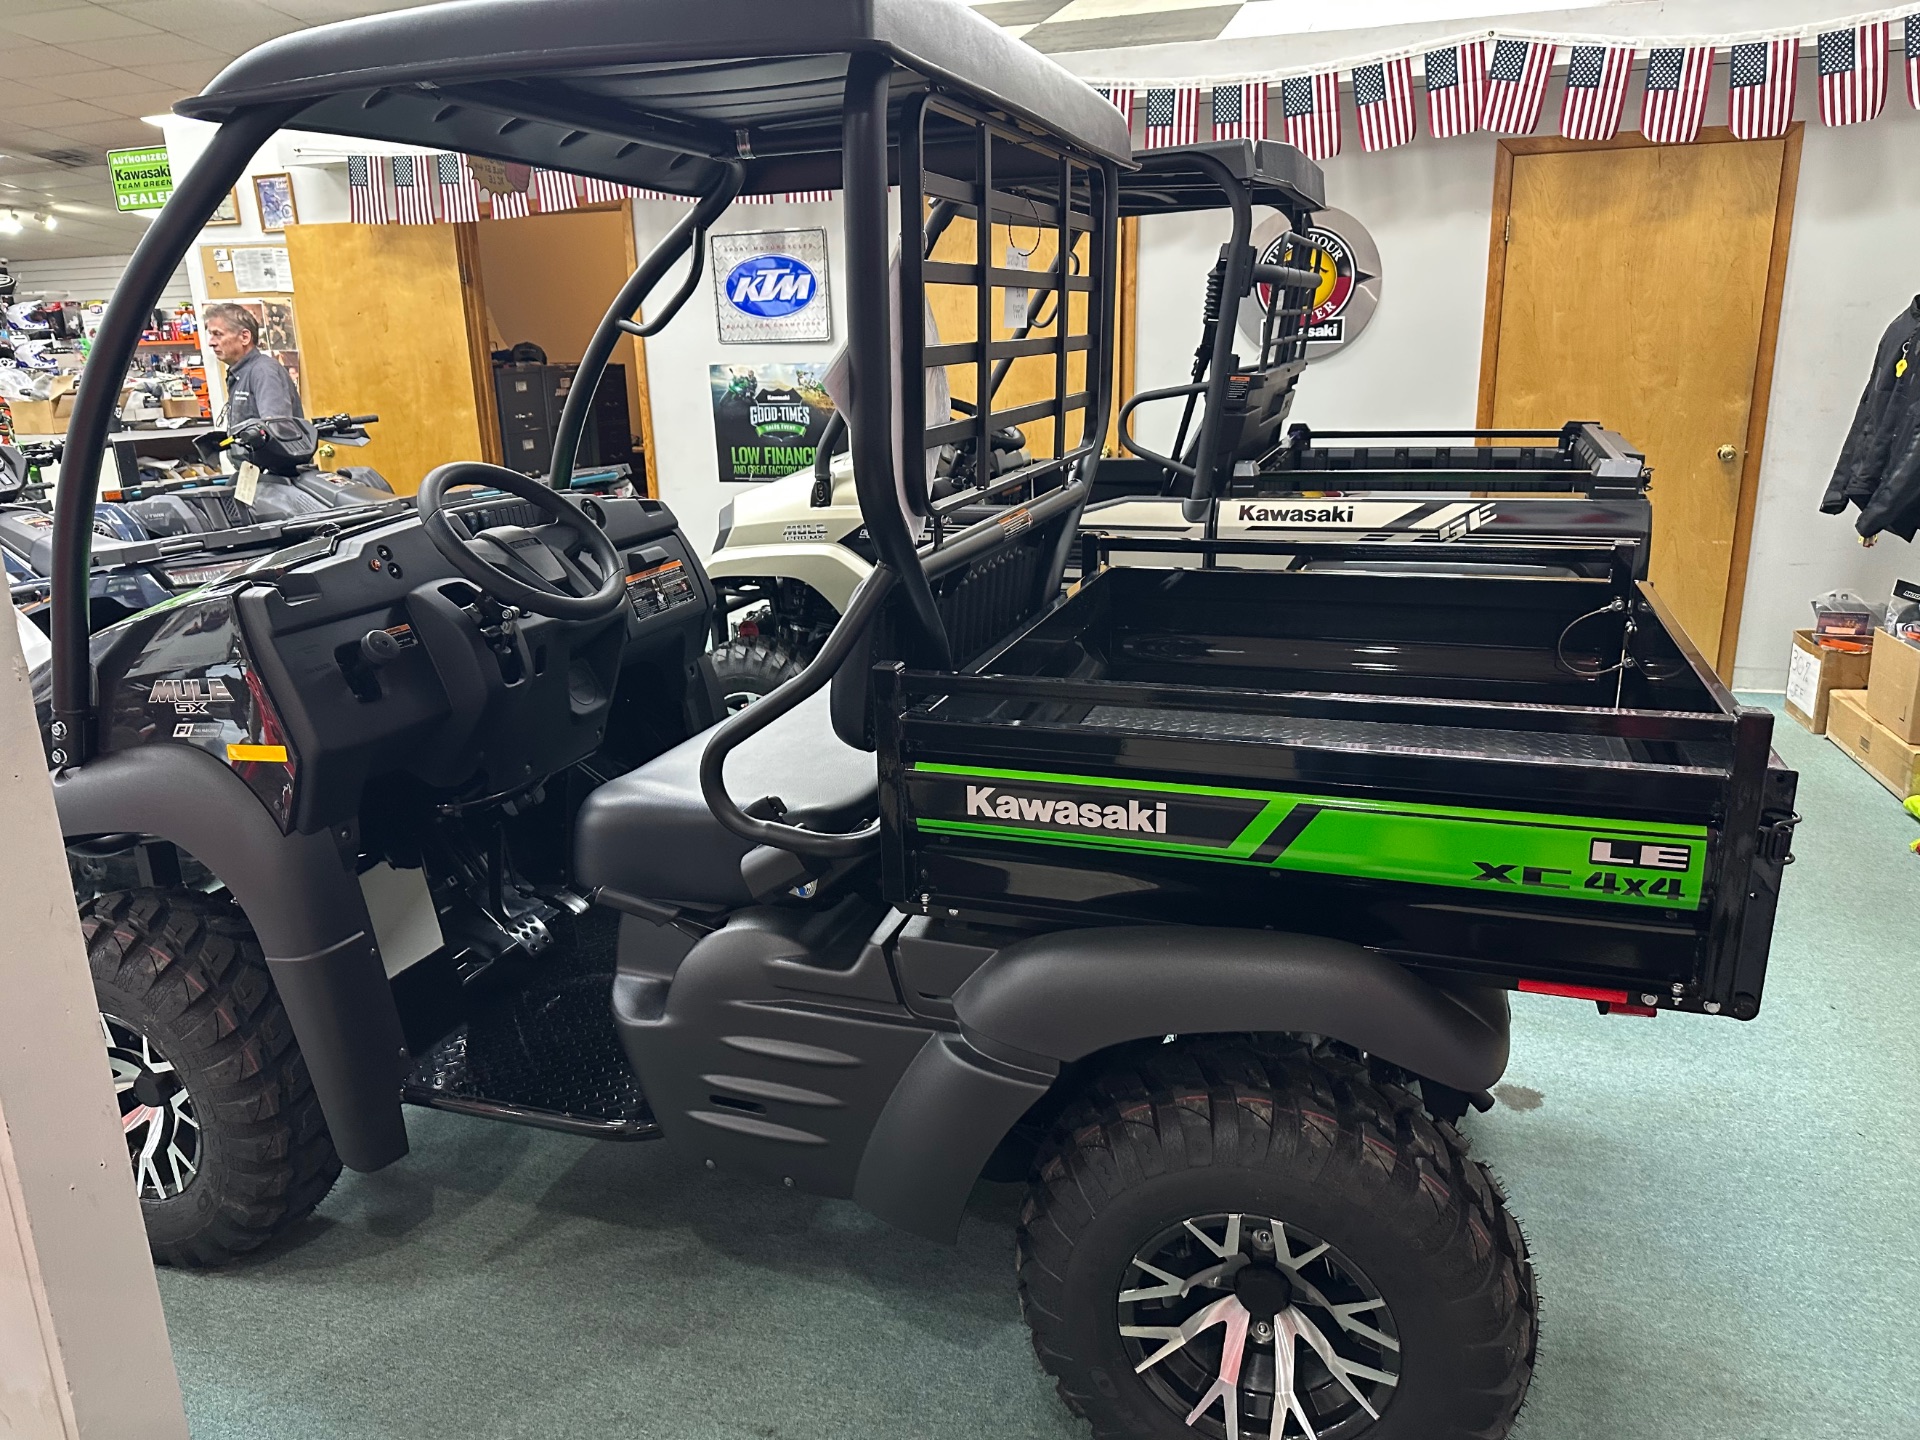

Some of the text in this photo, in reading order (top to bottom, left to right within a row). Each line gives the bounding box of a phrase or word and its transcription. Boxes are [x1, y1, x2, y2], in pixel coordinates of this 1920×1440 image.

[113, 153, 168, 164] AUTHORIZED
[115, 164, 171, 181] Kawasaki
[1309, 233, 1343, 261] TOUR
[733, 268, 811, 302] KTM
[731, 446, 818, 465] LOW FINANCI
[733, 465, 746, 474] AND
[747, 465, 767, 475] GREAT
[768, 465, 797, 474] FACTORY
[1238, 505, 1354, 523] Kawasaki
[782, 524, 828, 536] MULE
[148, 678, 235, 703] MULE
[174, 702, 209, 714] SX
[966, 785, 1167, 834] Kawasaki
[1591, 840, 1690, 869] LE
[1471, 861, 1687, 901] XC 4x4
